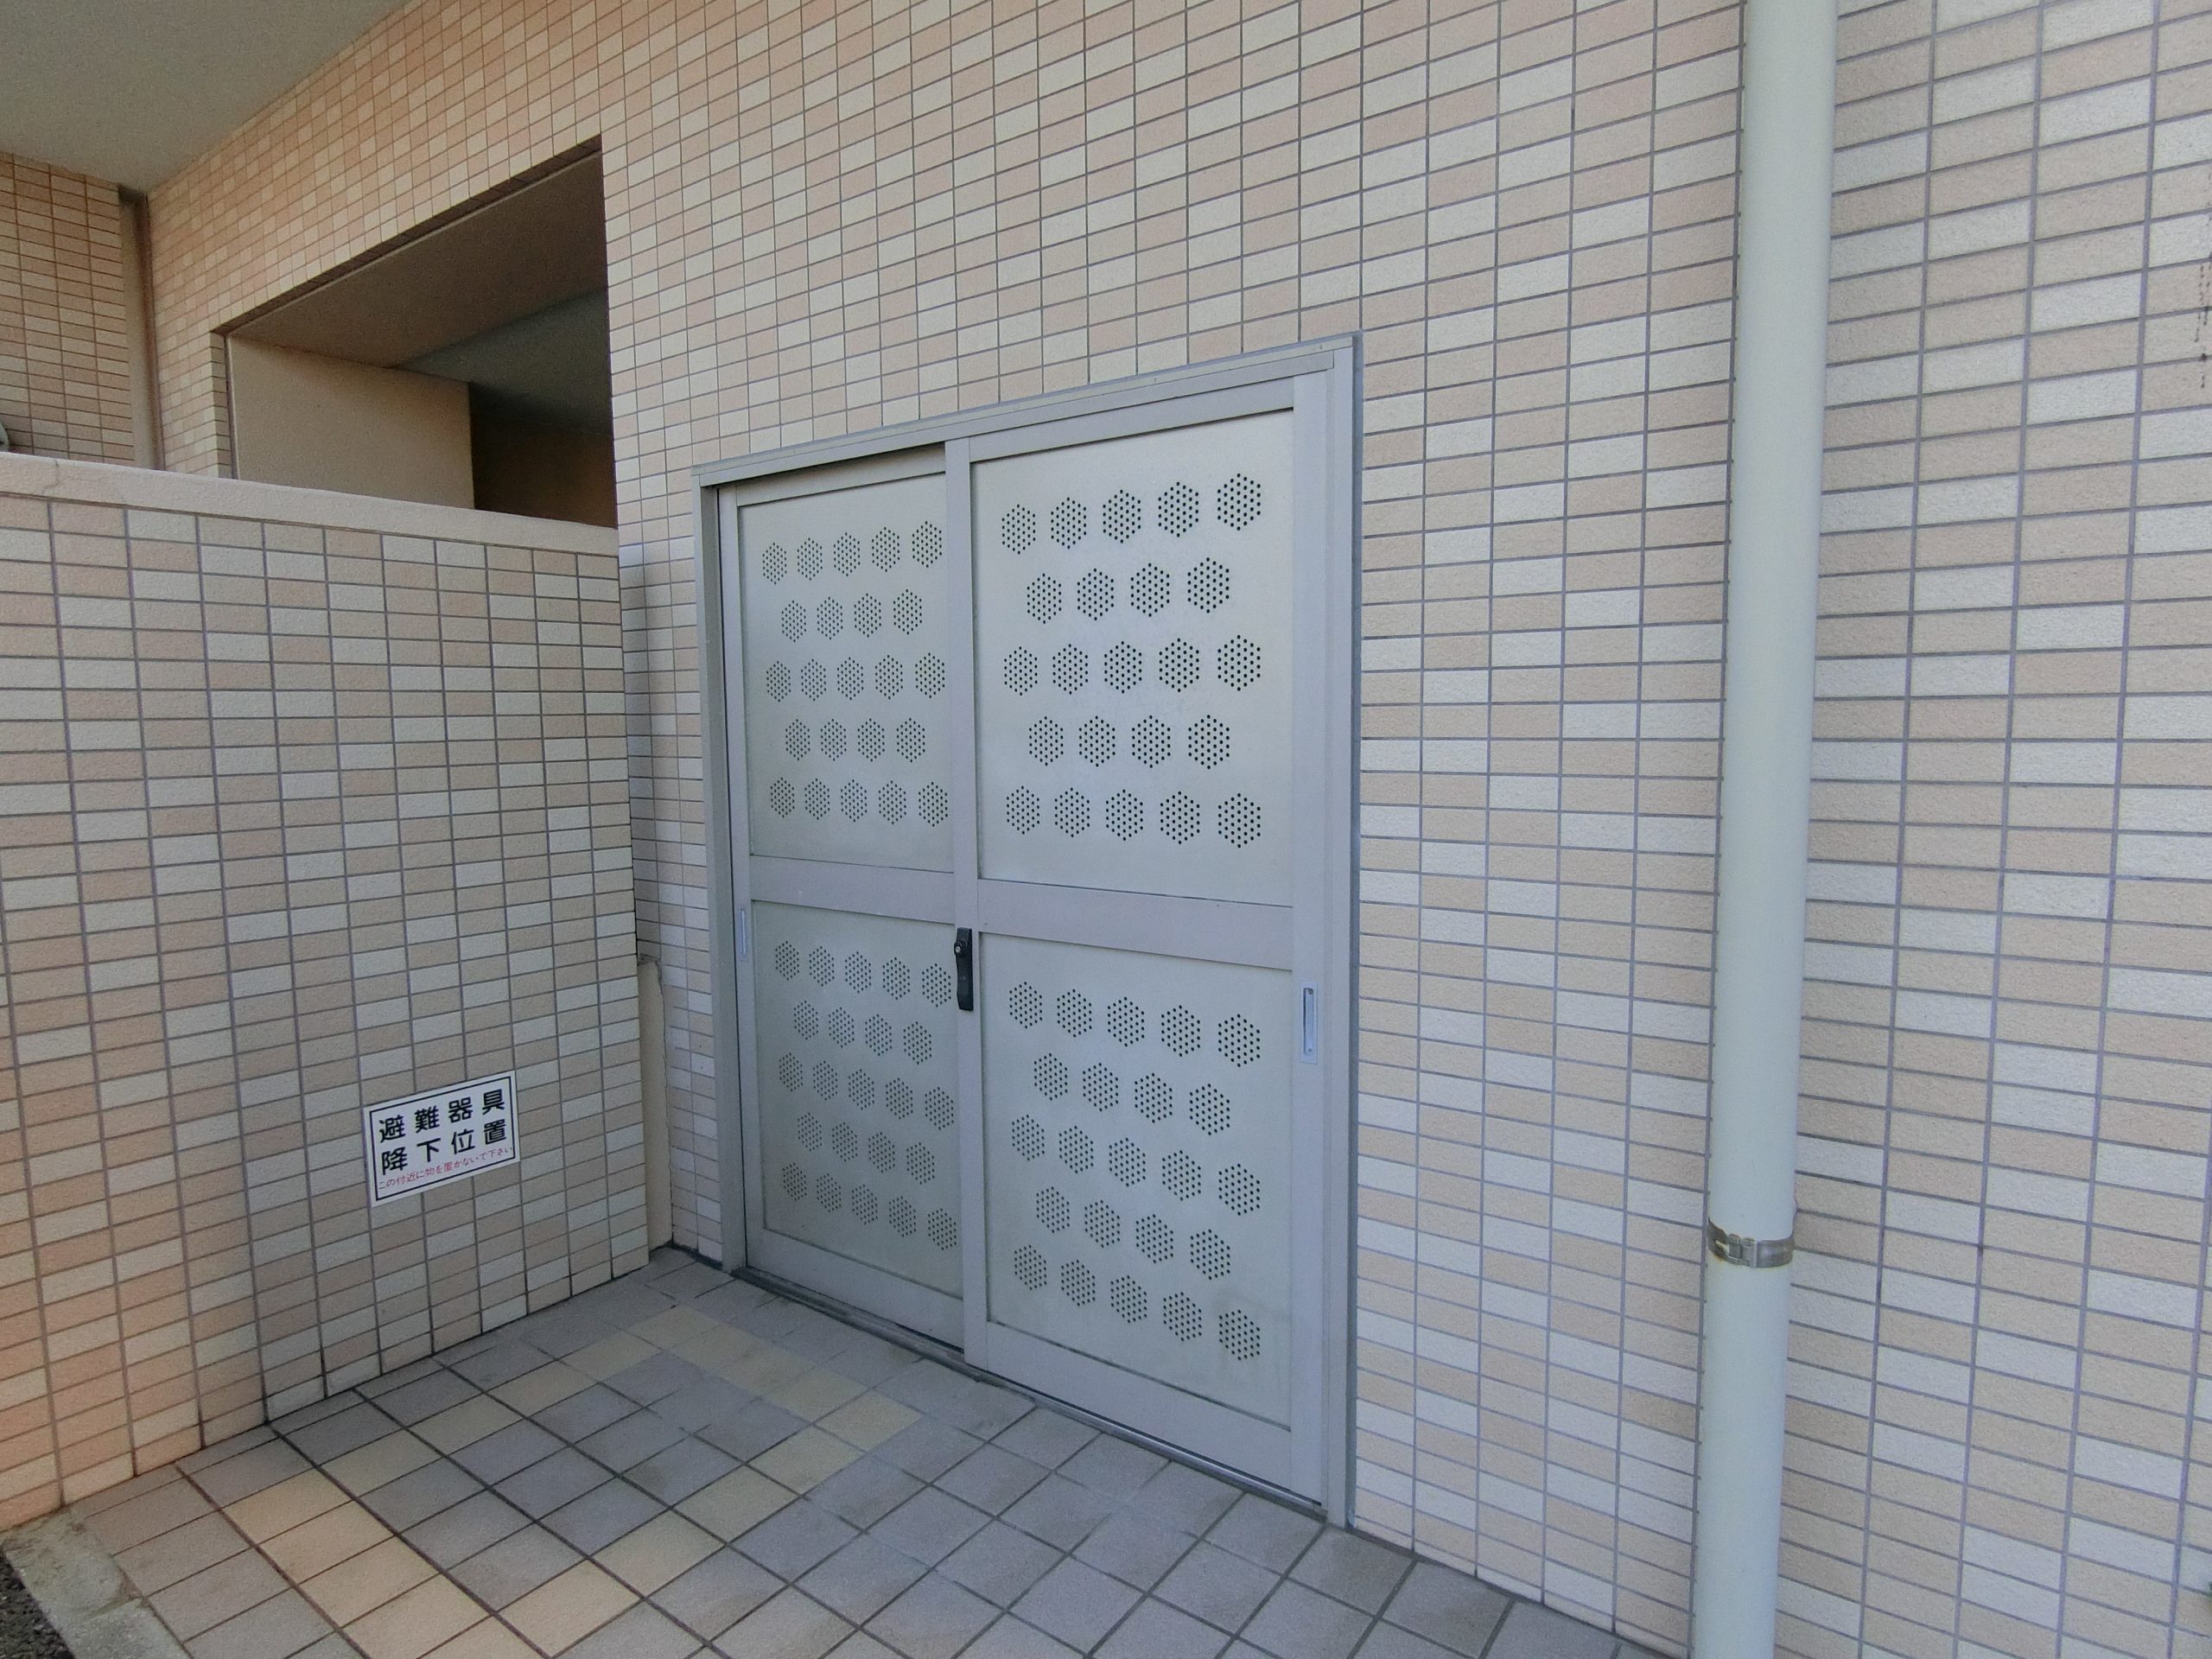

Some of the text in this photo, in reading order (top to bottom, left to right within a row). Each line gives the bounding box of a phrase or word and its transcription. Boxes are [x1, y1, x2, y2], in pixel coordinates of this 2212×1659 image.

[378, 1088, 505, 1143] 避難器具
[382, 1118, 507, 1176] 降下位置
